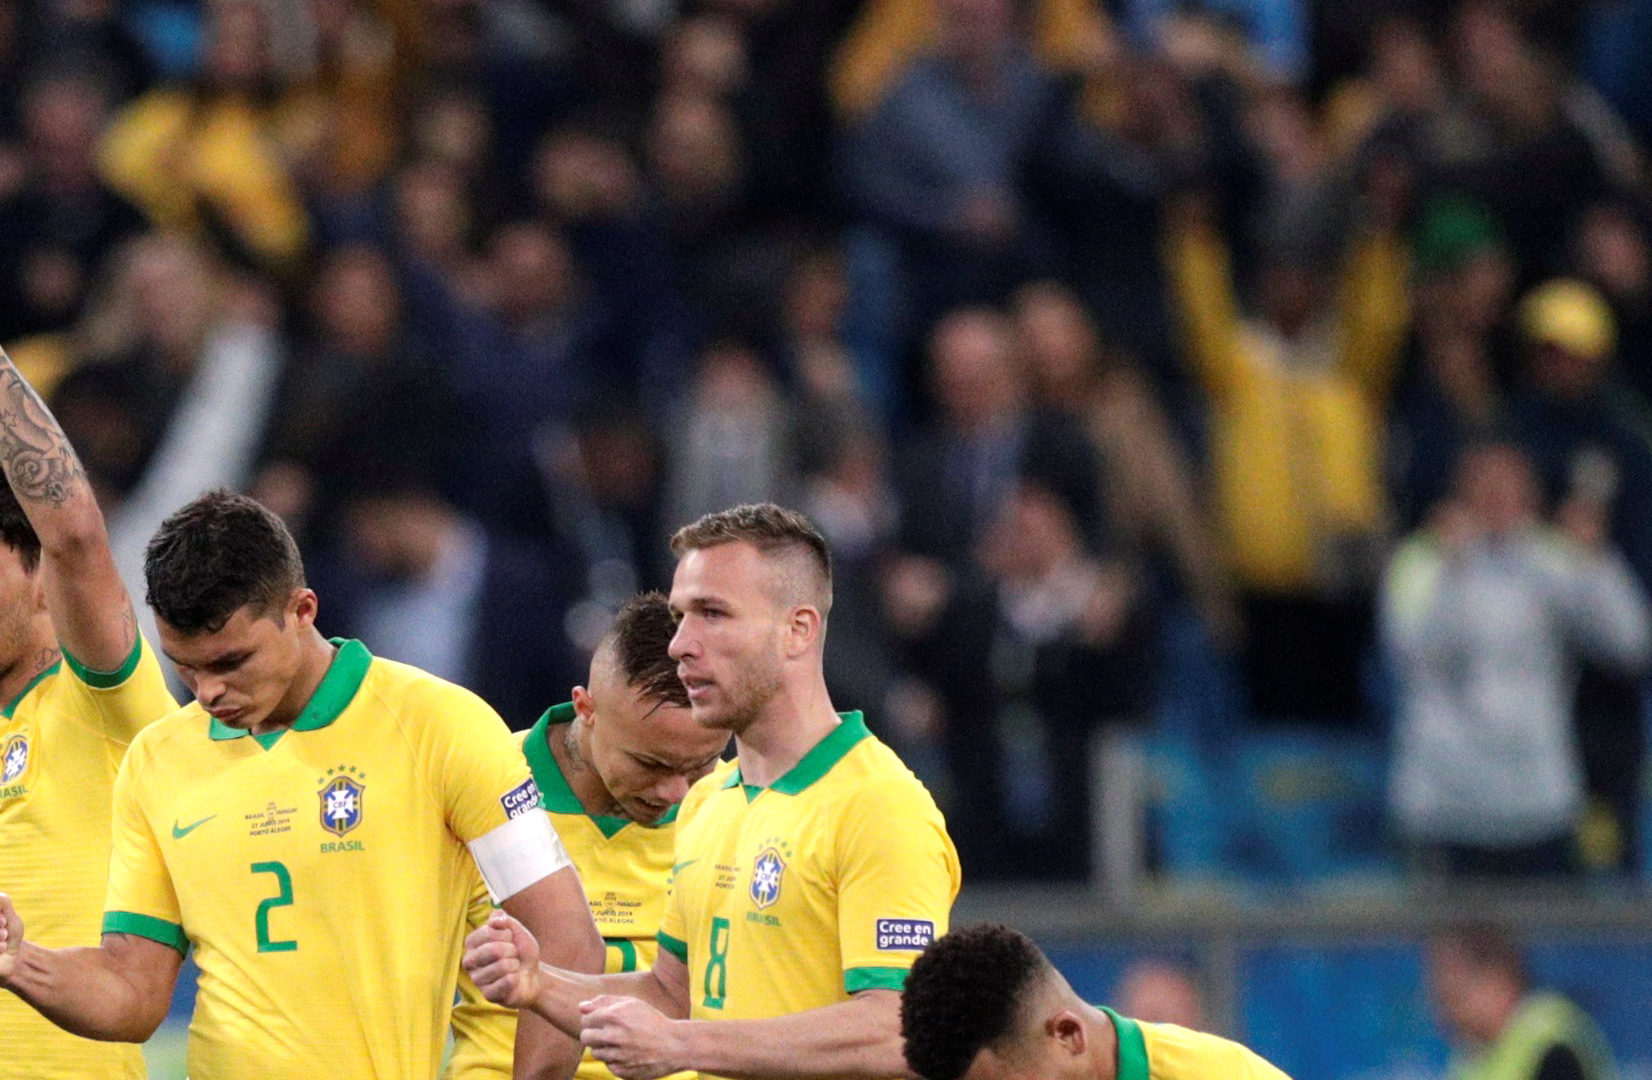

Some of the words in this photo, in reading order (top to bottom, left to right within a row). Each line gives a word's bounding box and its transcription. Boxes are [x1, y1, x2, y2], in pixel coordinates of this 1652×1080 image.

[333, 801, 347, 809] CBF
[504, 789, 529, 808] Cree
[320, 841, 366, 854] BRASIL
[250, 860, 298, 953] 2
[746, 911, 782, 927] BRASIL
[879, 920, 912, 933] Cree
[914, 924, 931, 935] en
[879, 934, 929, 948] grande
[703, 916, 730, 1010] 8
